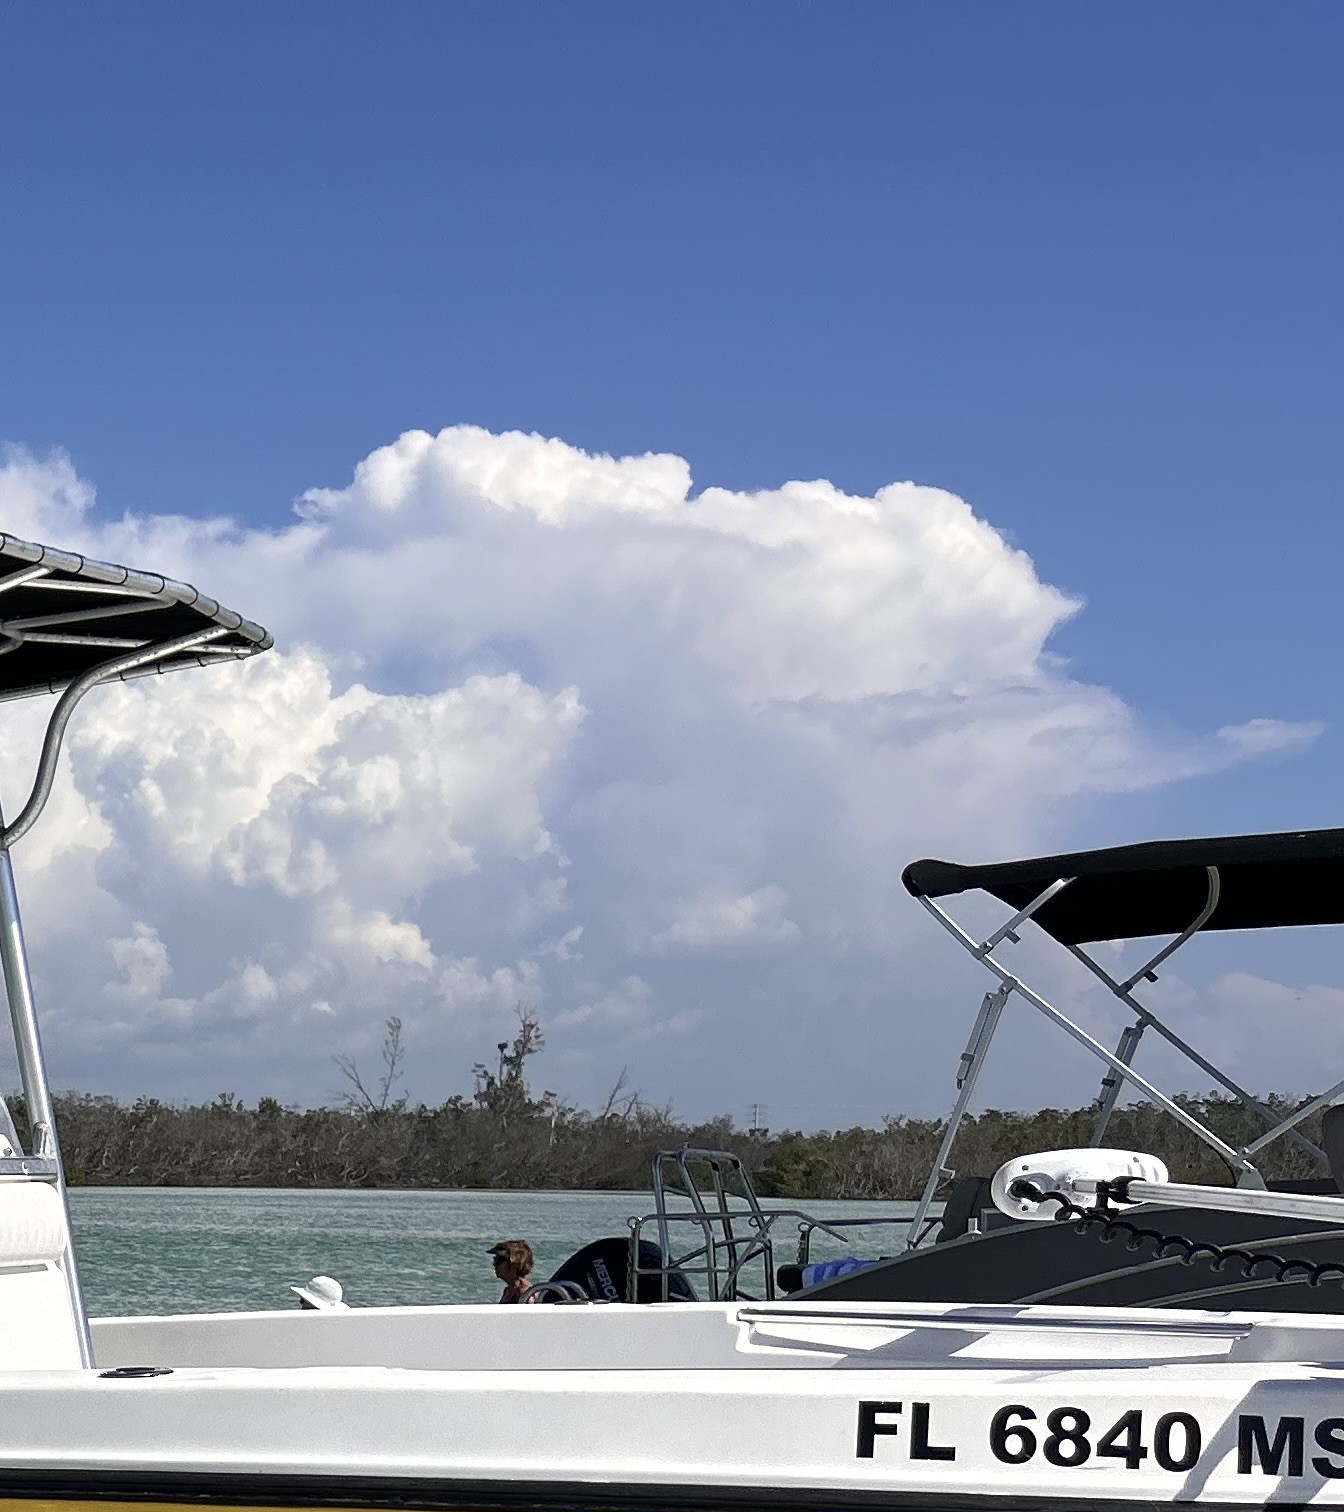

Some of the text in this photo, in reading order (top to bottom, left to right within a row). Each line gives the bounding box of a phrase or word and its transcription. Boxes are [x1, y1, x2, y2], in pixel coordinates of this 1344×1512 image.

[856, 1401, 1344, 1479] FL 6840 MS
